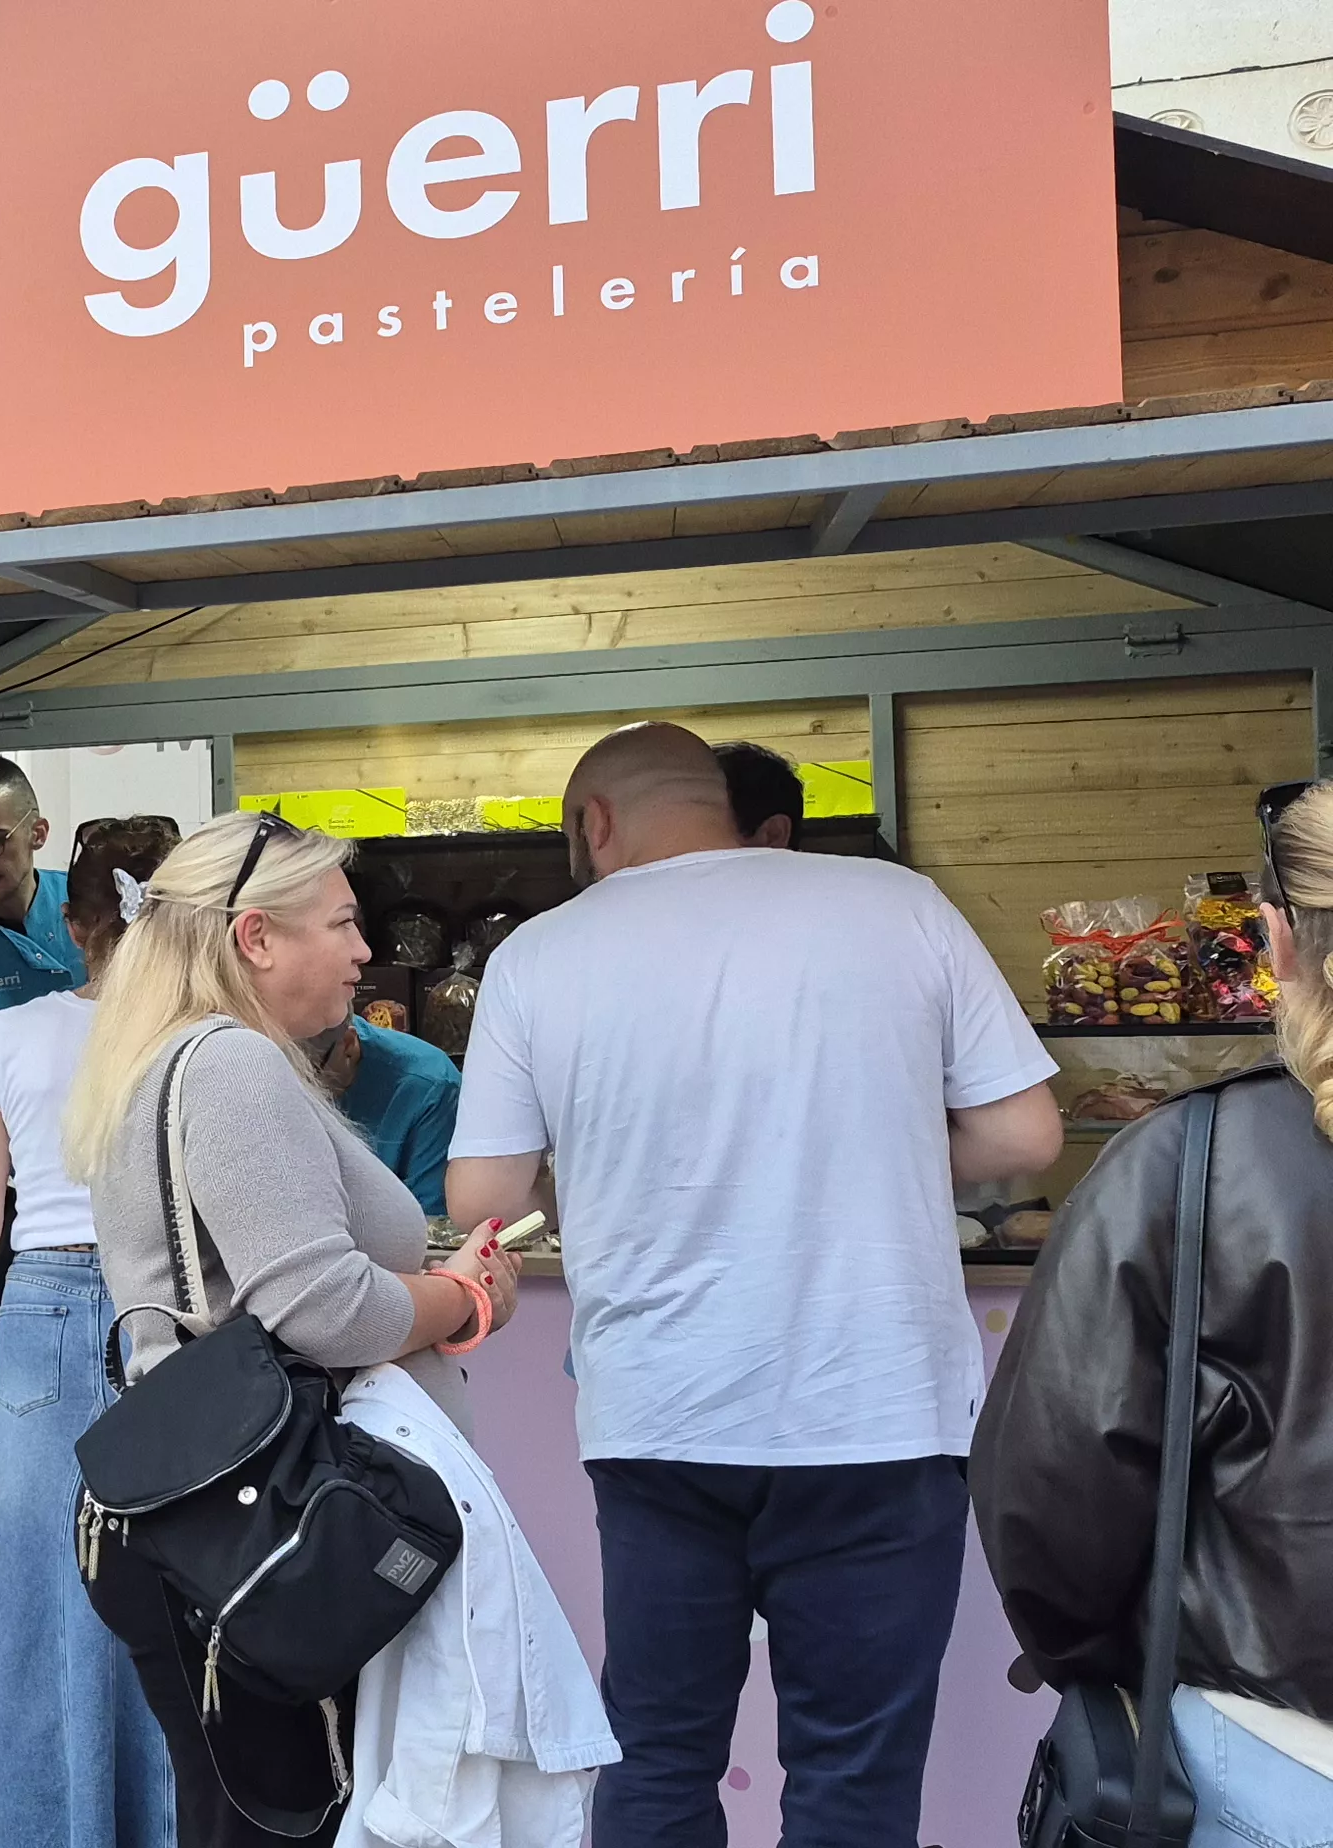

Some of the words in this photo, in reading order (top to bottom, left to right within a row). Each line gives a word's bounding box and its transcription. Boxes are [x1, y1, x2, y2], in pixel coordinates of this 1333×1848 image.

[80, 0, 815, 337] güerri
[243, 247, 819, 367] pastelería
[387, 1549, 416, 1580] PMZ
